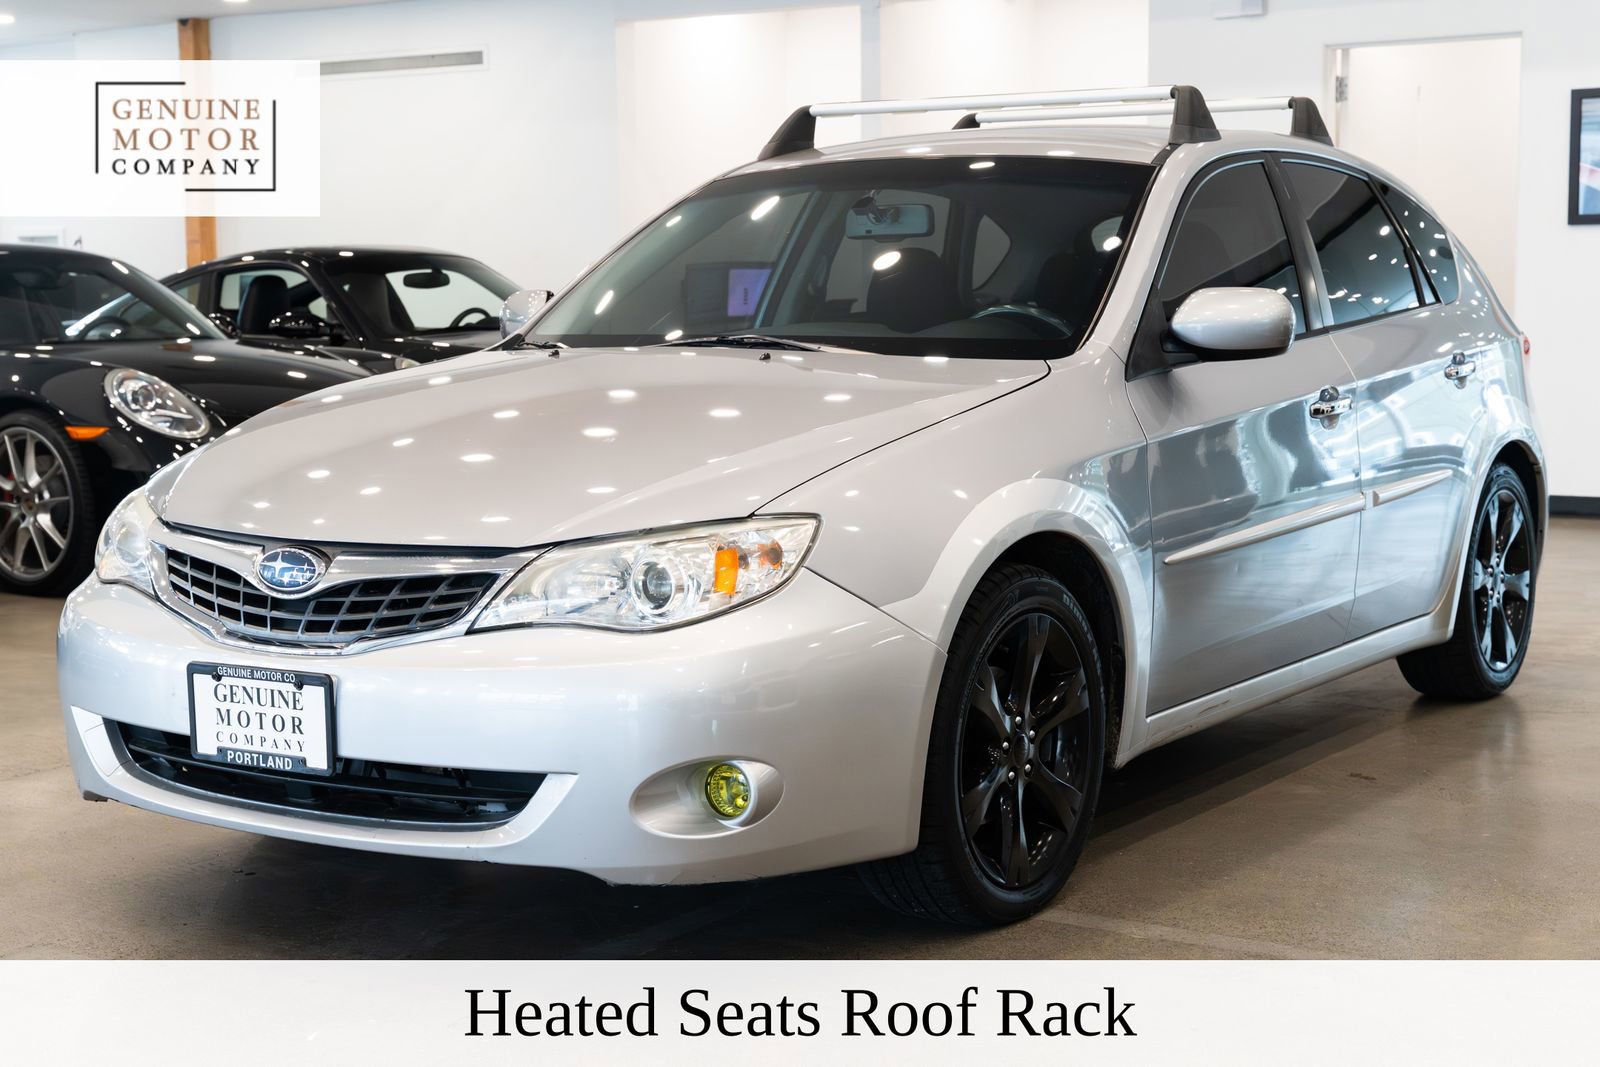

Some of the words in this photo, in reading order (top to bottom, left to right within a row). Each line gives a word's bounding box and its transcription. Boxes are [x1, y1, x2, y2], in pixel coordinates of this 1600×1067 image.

[217, 666, 252, 679] GENUINE
[253, 671, 283, 681] MOTOR
[213, 683, 304, 711] GENUINE
[215, 707, 305, 735] MOTOR
[215, 731, 305, 752] COMPANY
[227, 750, 293, 770] PORTLAND
